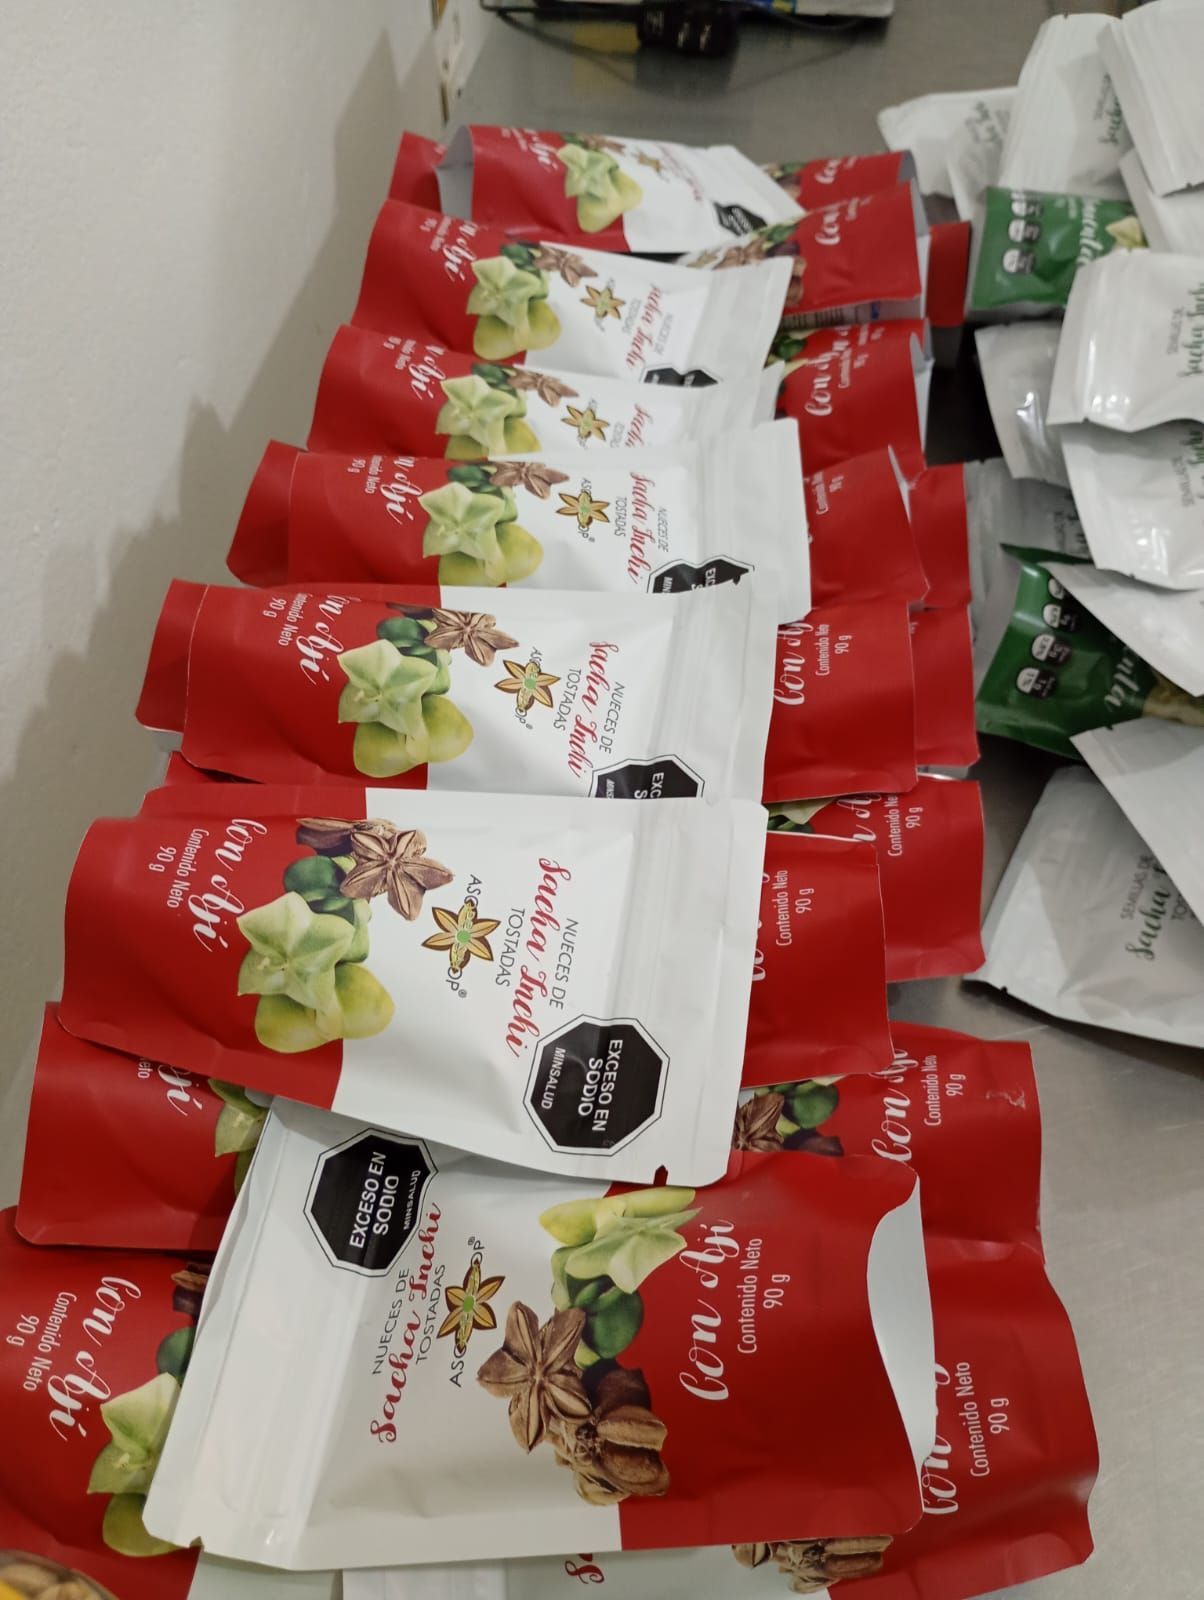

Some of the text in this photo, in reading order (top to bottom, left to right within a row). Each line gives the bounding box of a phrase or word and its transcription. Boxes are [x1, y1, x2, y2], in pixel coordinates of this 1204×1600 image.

[803, 374, 833, 417] Con
[380, 472, 423, 525] Ají
[627, 471, 657, 585] Sacha Inchi
[262, 596, 288, 619] 90 g
[277, 623, 300, 647] Neto
[296, 622, 345, 686] Ají
[771, 649, 806, 706] Con
[813, 636, 832, 677] Contenido
[833, 633, 852, 655] 90 g
[552, 667, 582, 732] TOSTADAS
[567, 640, 619, 779] Sacha Inchi
[598, 680, 626, 754] NUECES DE
[881, 811, 904, 857] Contenido
[905, 805, 924, 829] 90 g
[148, 845, 177, 873] 90 g
[166, 827, 210, 909] Contenido Neto
[187, 818, 268, 953] Con Ají
[770, 869, 794, 947] Contenido Neto
[794, 887, 816, 915] 90 g
[1124, 886, 1172, 962] Sacha
[494, 906, 526, 989] TOSTADAS
[504, 856, 573, 1059] Sacha Inchi
[548, 916, 580, 1011] NUECES DE
[136, 1058, 151, 1080] eto
[539, 1046, 567, 1111] MINSALUD
[576, 1057, 604, 1118] SODIO
[591, 1037, 624, 1133] EXCESO EN
[920, 1054, 943, 1128] Contenido Neto
[945, 1072, 967, 1098] 90 g
[870, 1088, 914, 1163] Con
[348, 1150, 388, 1250] EXCESO EN
[371, 1174, 400, 1237] SODIO
[402, 1168, 422, 1232] MINSALUD
[369, 1201, 443, 1444] Sacha Inchi
[371, 1266, 410, 1376] NUECES DE
[415, 1263, 446, 1365] TOSTADAS
[678, 1217, 741, 1402] Con Ají
[736, 1237, 764, 1355] Contenido Neto
[762, 1273, 791, 1310] 90 g
[6, 1313, 41, 1348] 90 g
[22, 1290, 78, 1393] Contenido Neto
[46, 1274, 143, 1442] Con Ají
[954, 1361, 991, 1478] Contenido Neto
[987, 1397, 1011, 1435] 90 g
